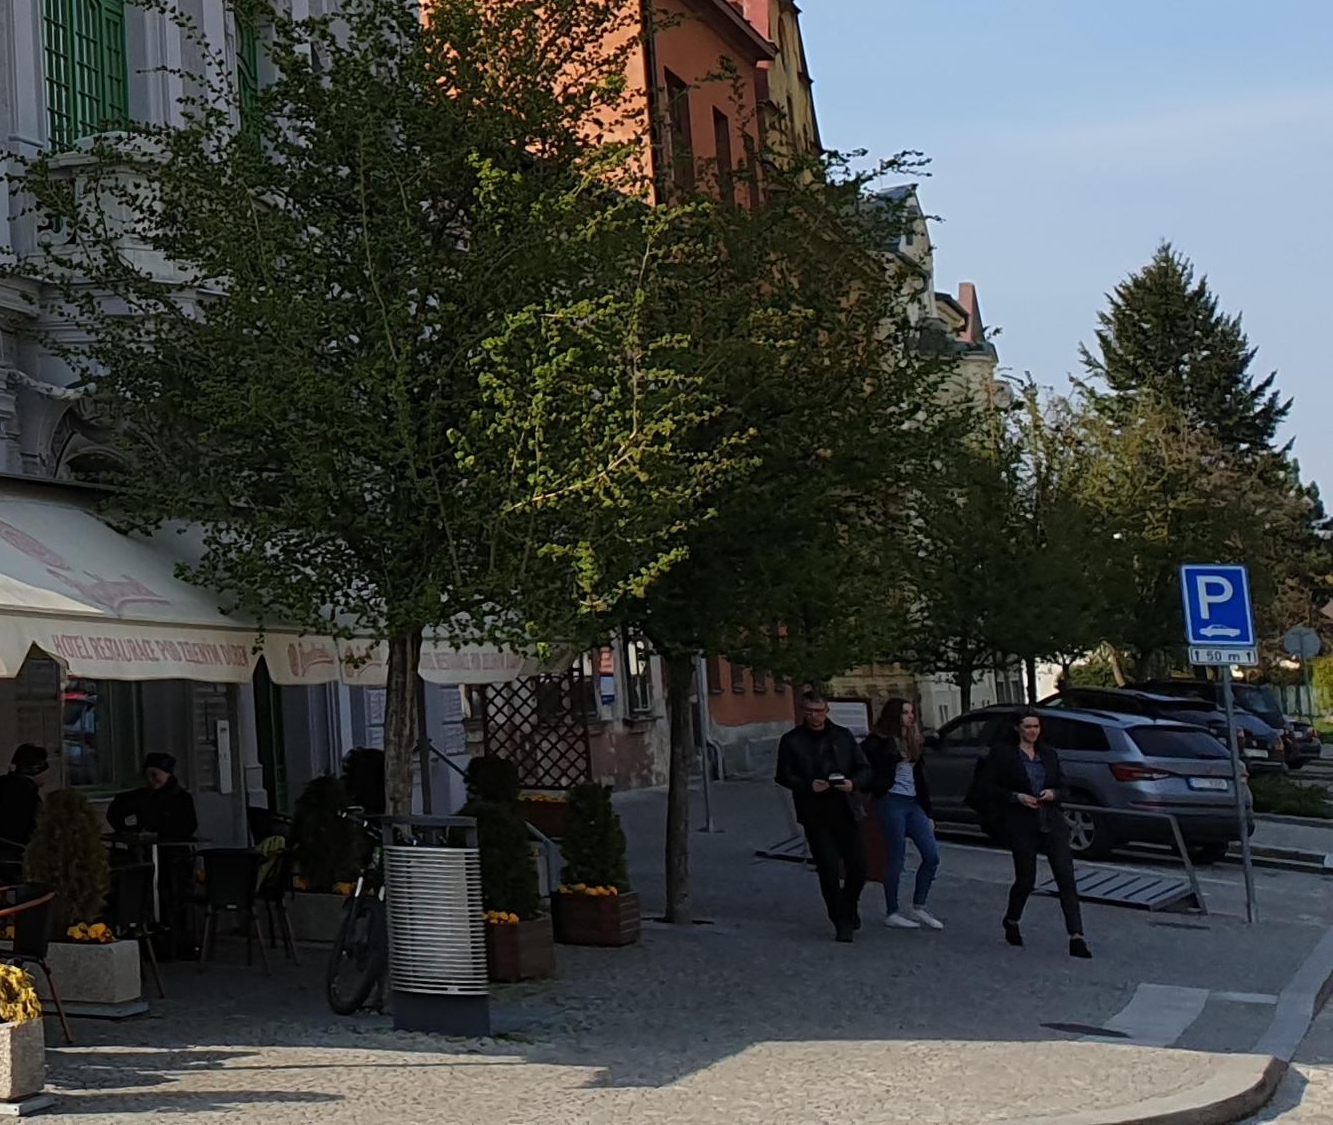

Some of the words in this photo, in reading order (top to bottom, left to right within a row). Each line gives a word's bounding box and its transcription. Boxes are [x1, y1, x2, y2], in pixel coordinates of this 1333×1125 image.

[1196, 575, 1234, 620] P
[51, 635, 93, 660] HOTEL
[1206, 651, 1222, 661] 50
[1228, 653, 1240, 661] m
